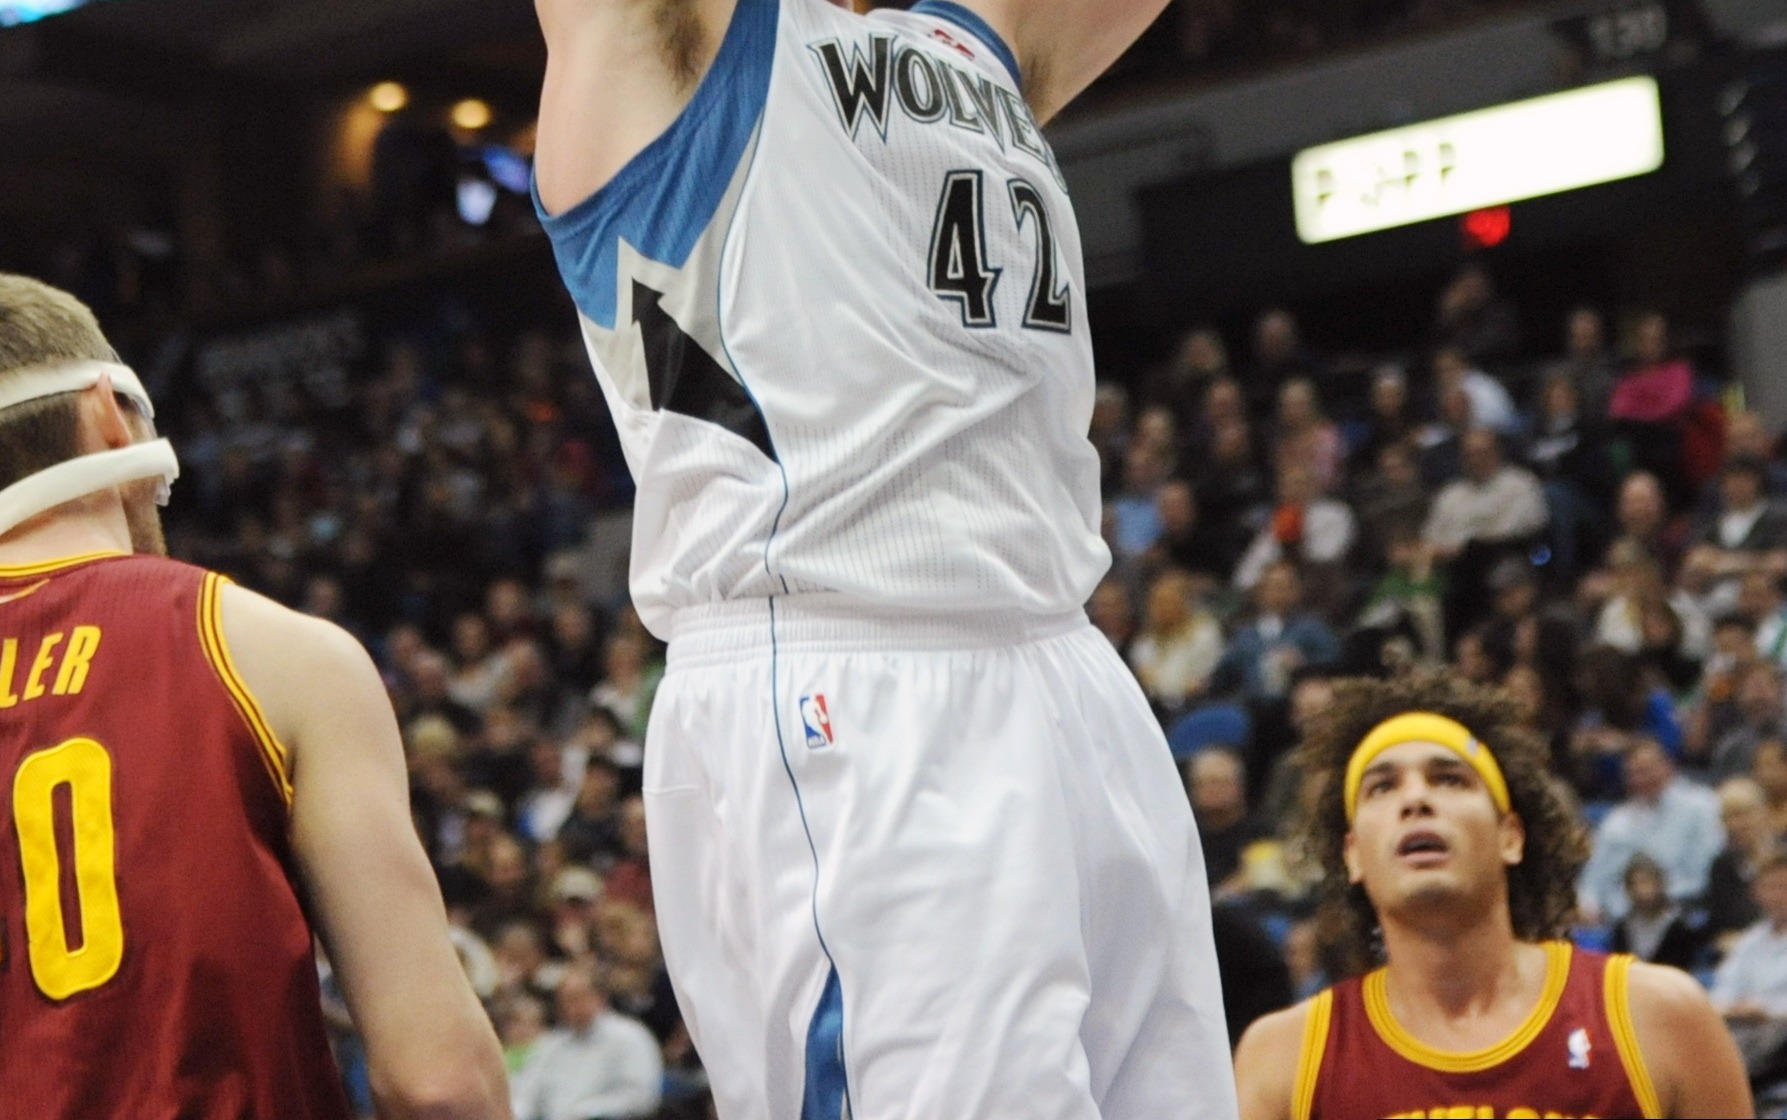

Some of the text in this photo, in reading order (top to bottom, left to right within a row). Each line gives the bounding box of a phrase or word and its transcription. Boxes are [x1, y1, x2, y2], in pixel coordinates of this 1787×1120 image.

[806, 32, 1068, 195] WOLVE
[927, 169, 1071, 335] 42
[0, 625, 101, 708] LER
[13, 737, 124, 1000] 0
